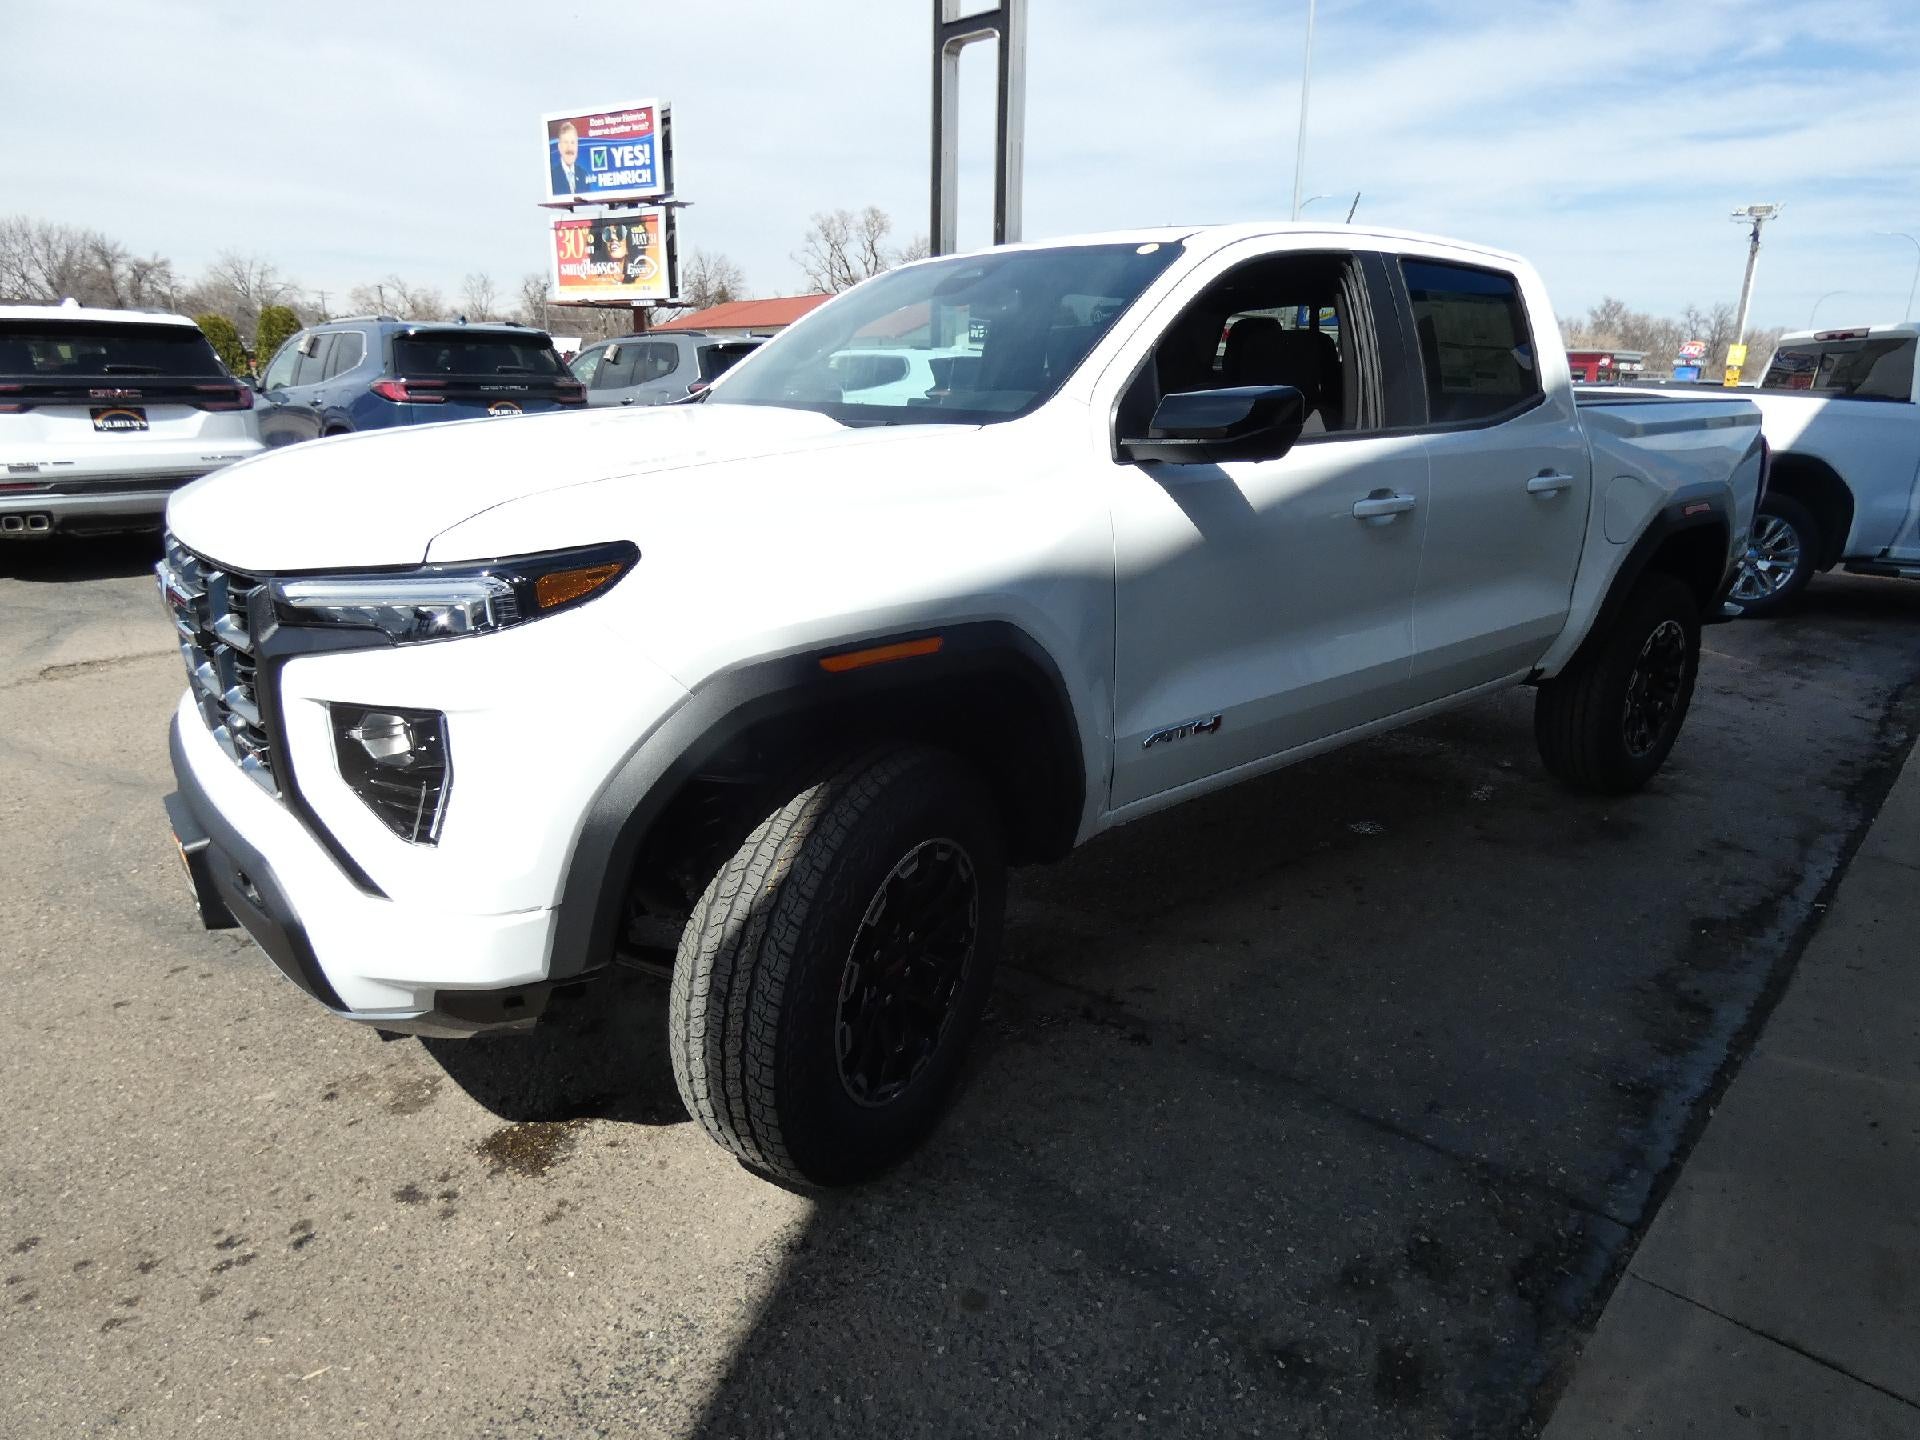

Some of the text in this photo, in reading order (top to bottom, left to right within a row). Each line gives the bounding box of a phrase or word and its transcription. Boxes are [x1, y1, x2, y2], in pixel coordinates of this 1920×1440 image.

[610, 143, 651, 168] YES!
[597, 169, 651, 187] HEINRICH
[631, 233, 648, 246] MAY
[560, 257, 621, 280] sunglasses
[89, 388, 143, 399] GMC
